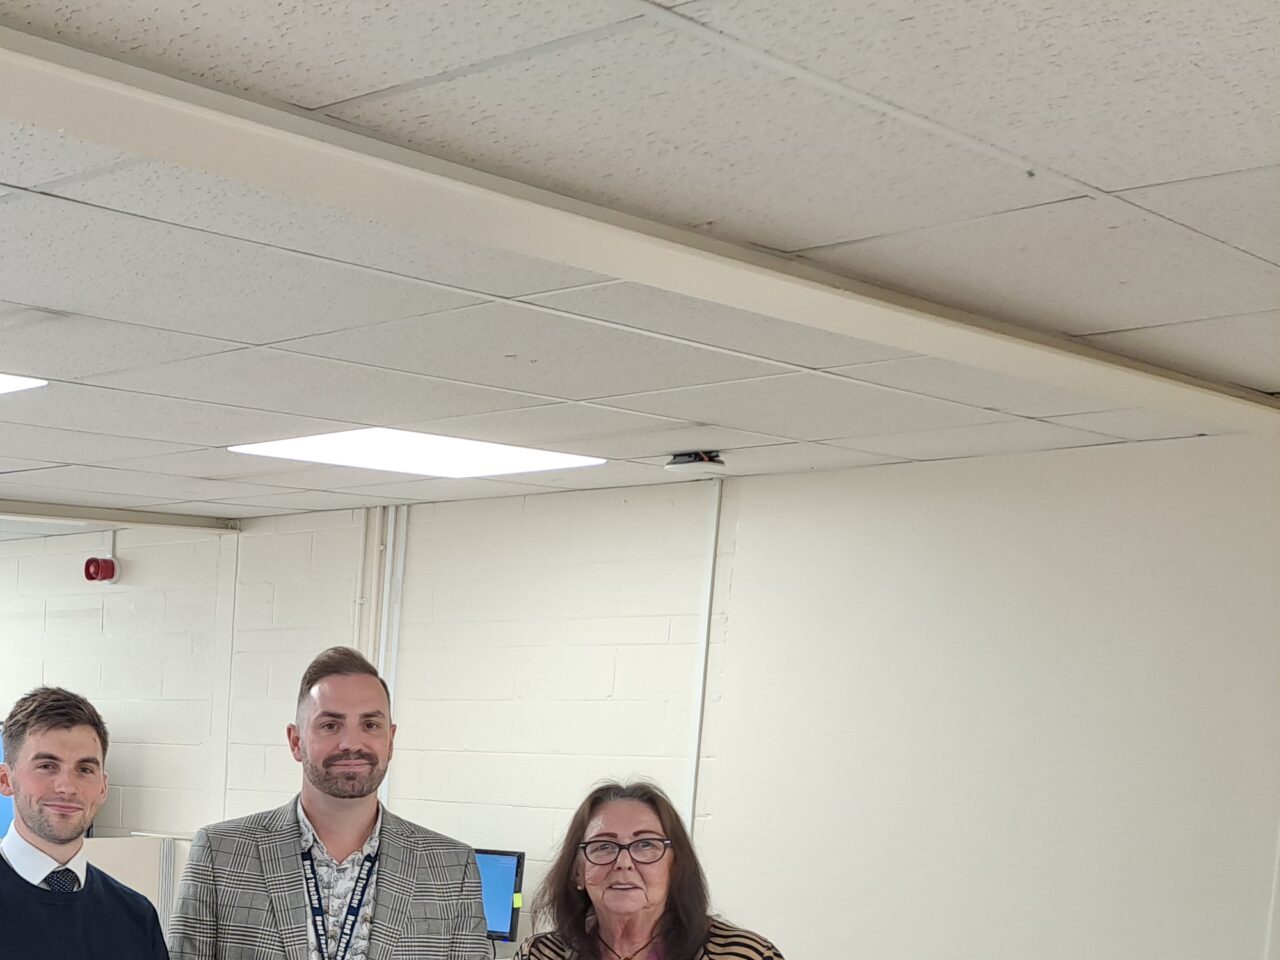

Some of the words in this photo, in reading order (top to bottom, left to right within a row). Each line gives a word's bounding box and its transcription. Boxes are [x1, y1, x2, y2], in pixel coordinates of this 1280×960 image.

[303, 860, 314, 878] Head
[360, 861, 372, 879] Head
[307, 878, 319, 908] Teacher
[351, 879, 366, 908] Teacher
[343, 915, 355, 934] Head
